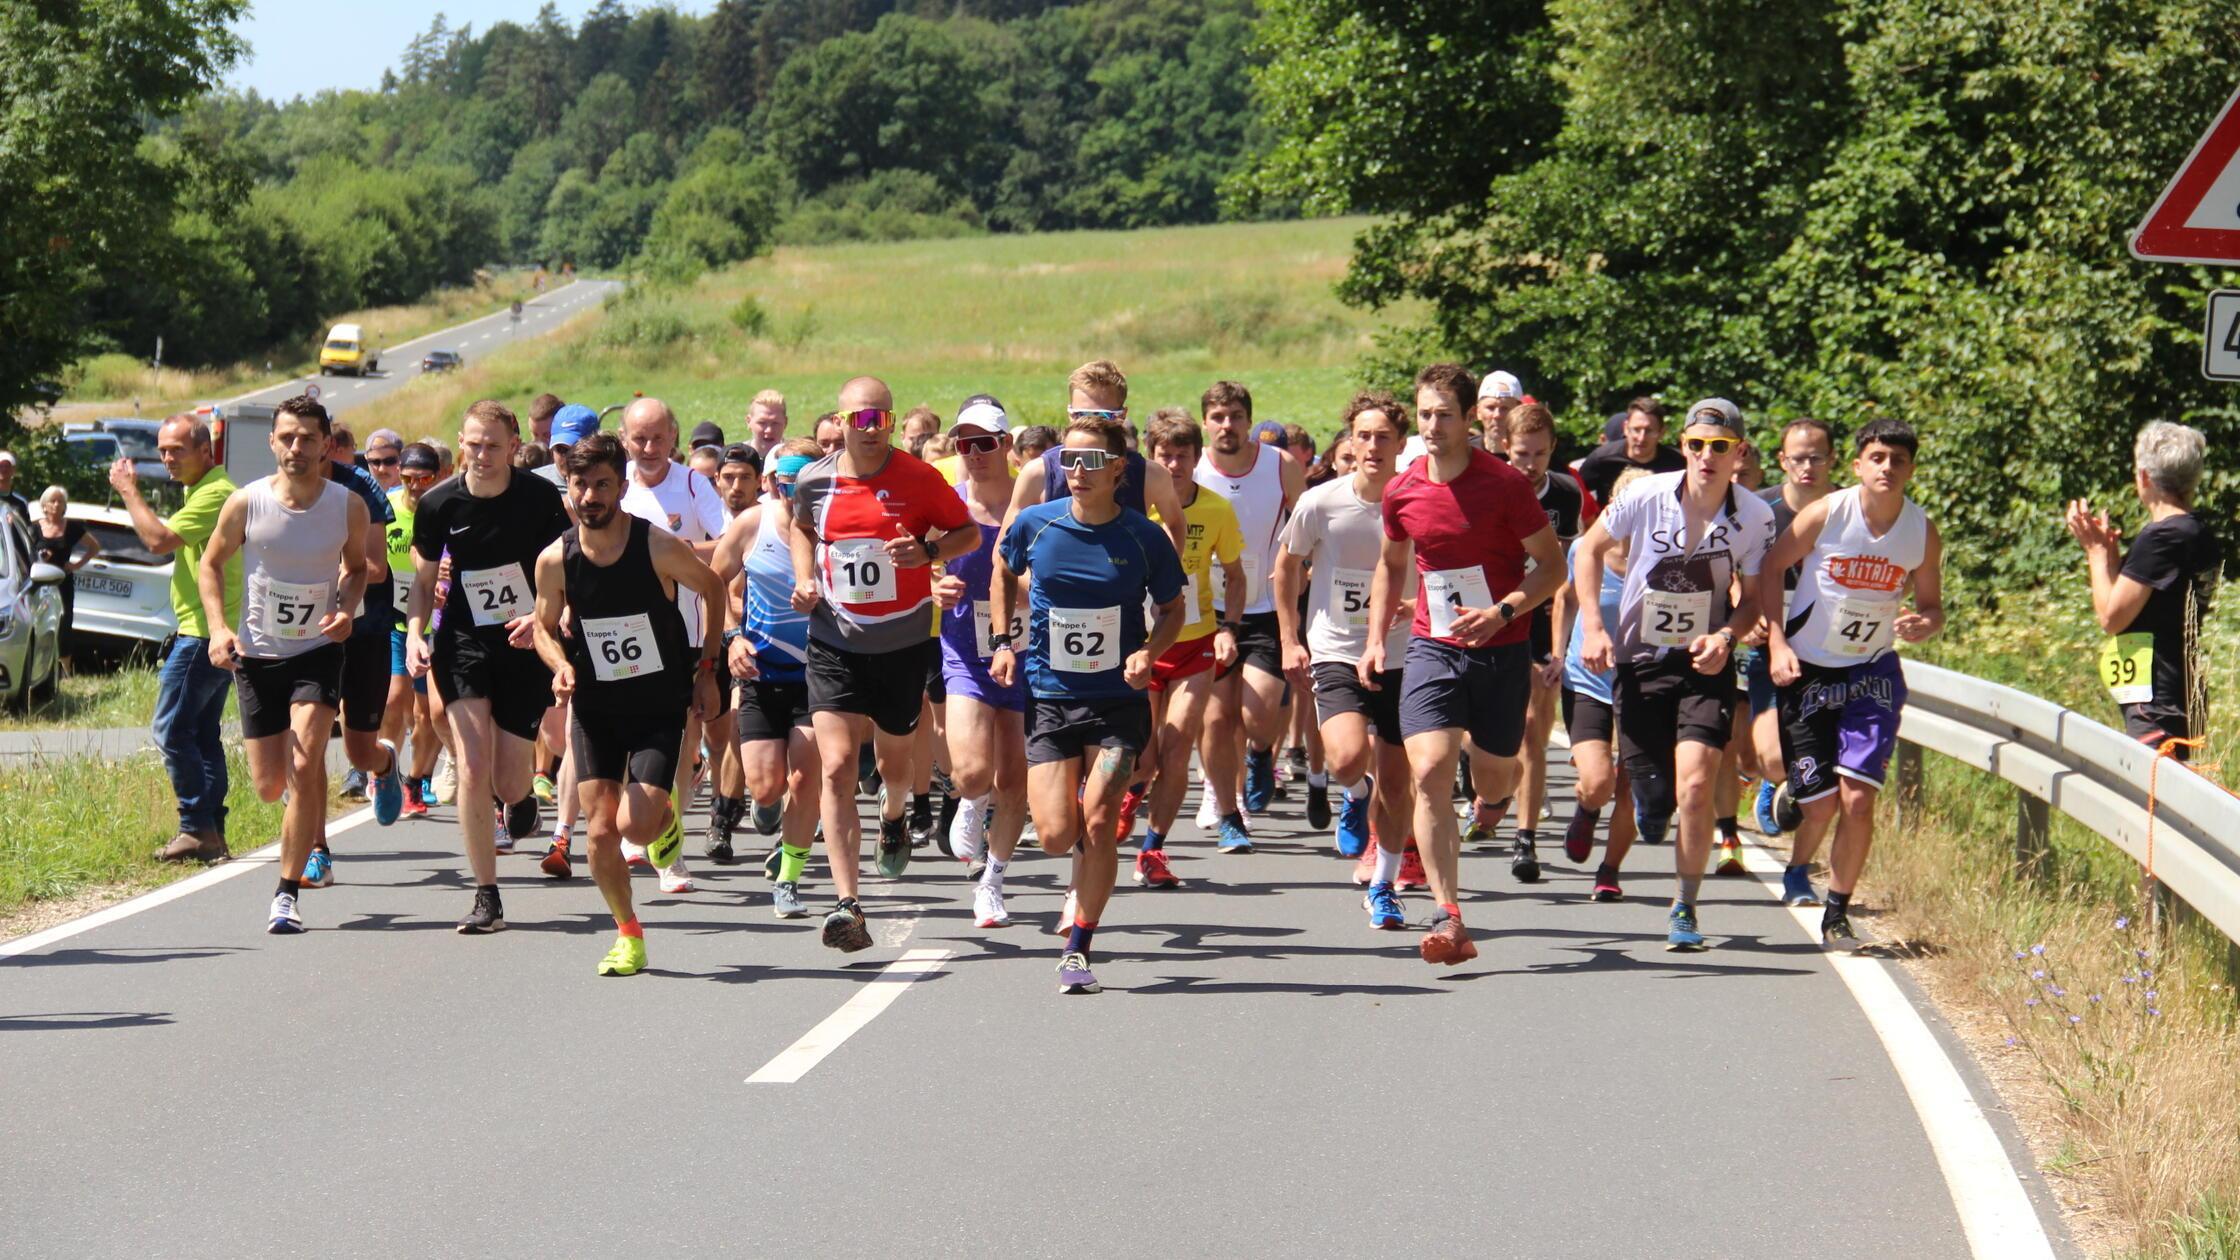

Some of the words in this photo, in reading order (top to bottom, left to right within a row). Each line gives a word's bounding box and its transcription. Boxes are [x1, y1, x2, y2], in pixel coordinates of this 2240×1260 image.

[92, 578, 106, 590] LR
[109, 580, 129, 593] 506
[843, 561, 880, 587] 10
[1334, 579, 1359, 588] Etappe
[269, 591, 293, 600] Etappe
[478, 585, 518, 610] 24
[277, 602, 315, 626] 57
[1052, 621, 1080, 630] Etappe
[1655, 610, 1695, 633] 25
[1840, 620, 1881, 642] 47
[601, 636, 642, 664] 66
[1064, 632, 1104, 656] 62
[2110, 657, 2136, 687] 39
